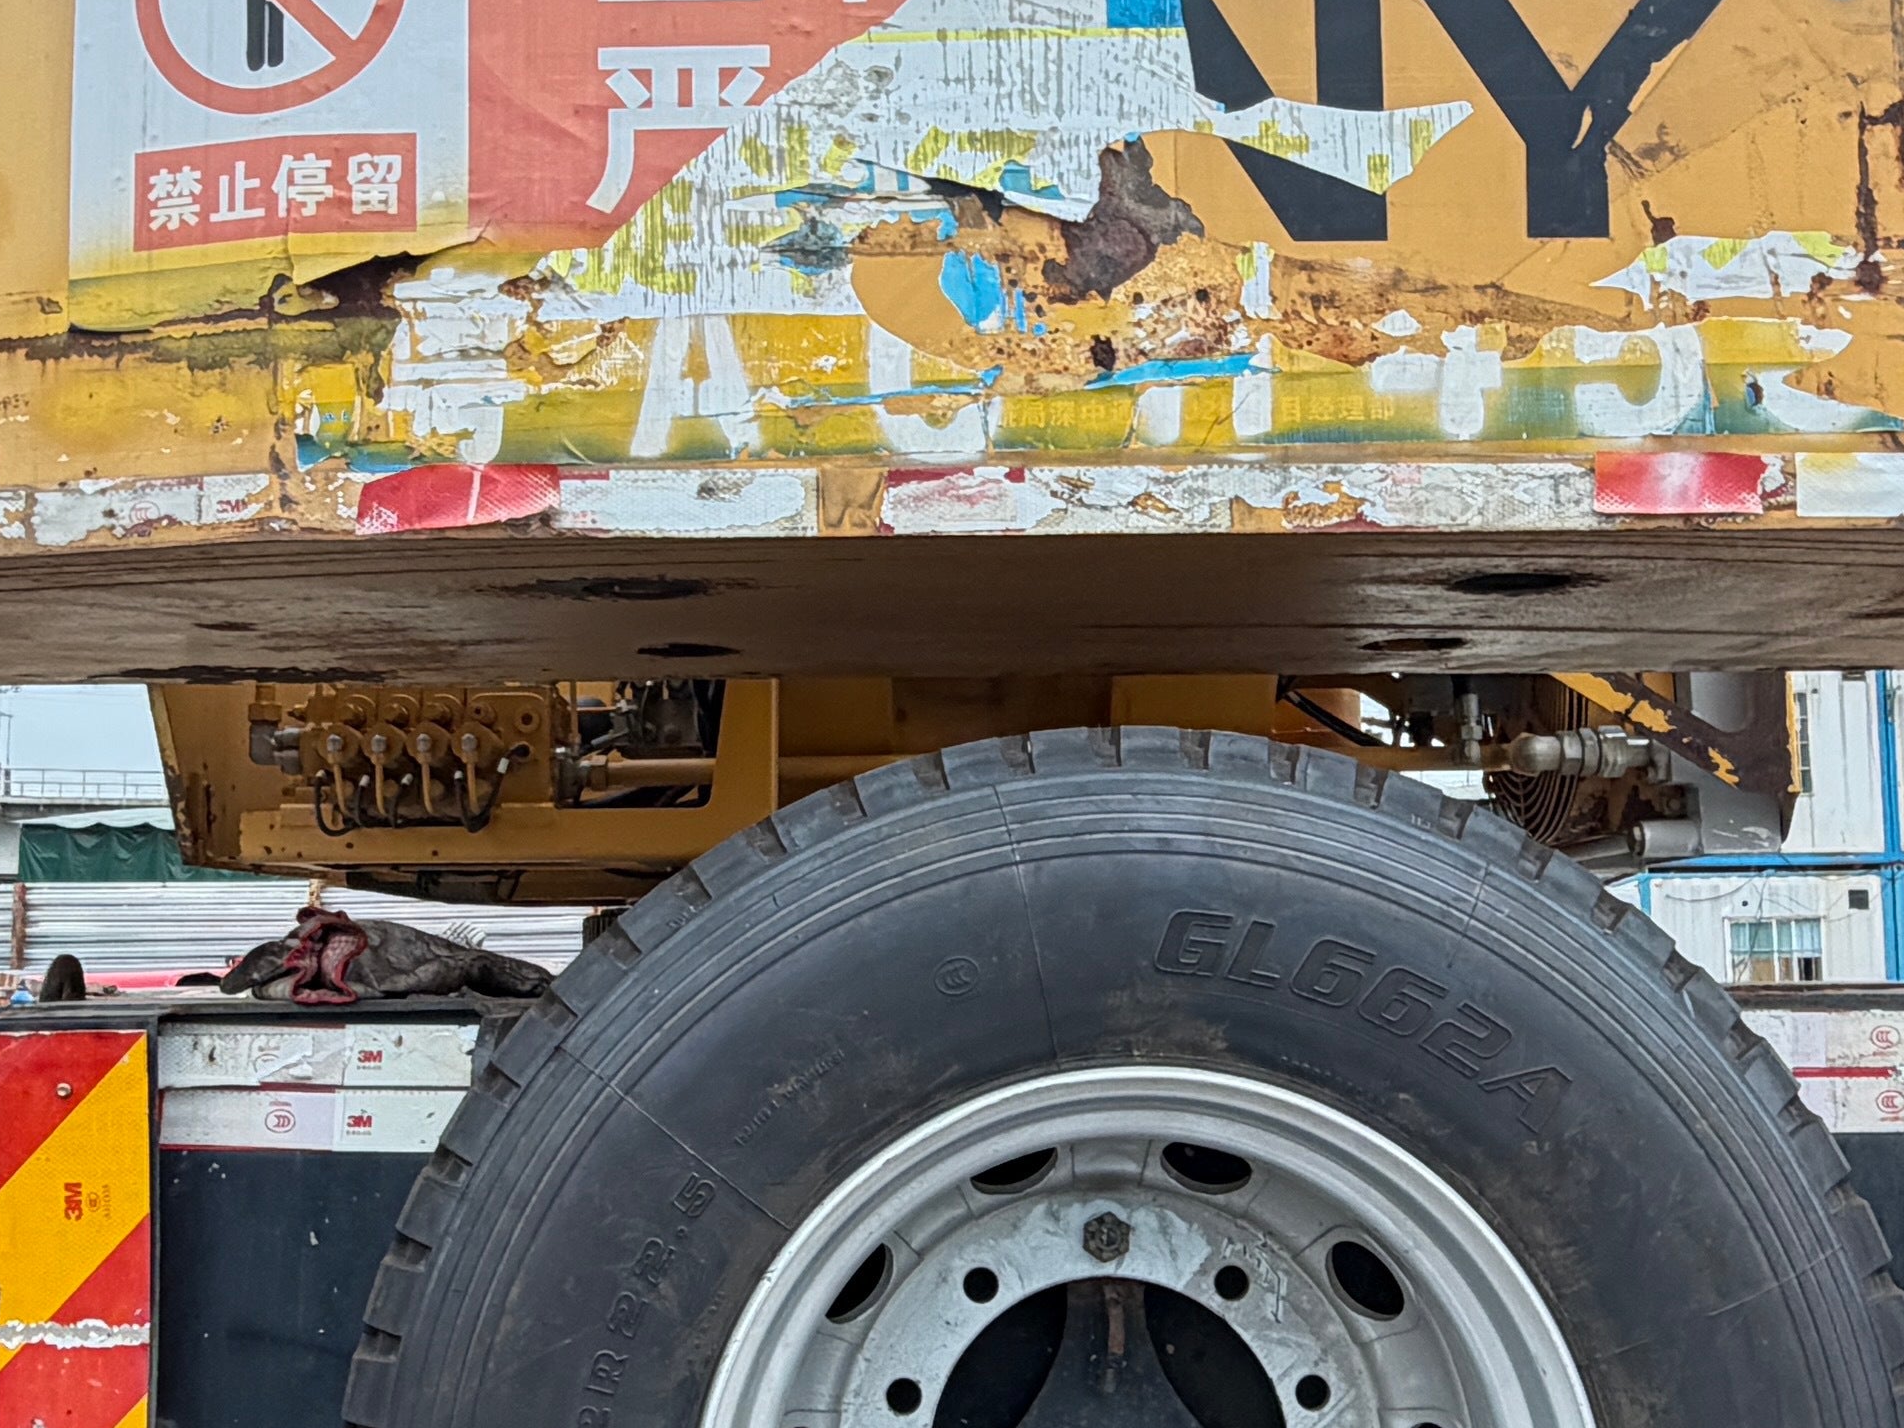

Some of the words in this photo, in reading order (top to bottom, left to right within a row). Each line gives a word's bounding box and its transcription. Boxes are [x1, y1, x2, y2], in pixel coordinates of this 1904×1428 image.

[146, 151, 404, 232] 禁止停留
[1154, 909, 1574, 1134] GL662A
[357, 1050, 383, 1063] 3M
[347, 1115, 372, 1127] 3M
[63, 1182, 83, 1221] 3M
